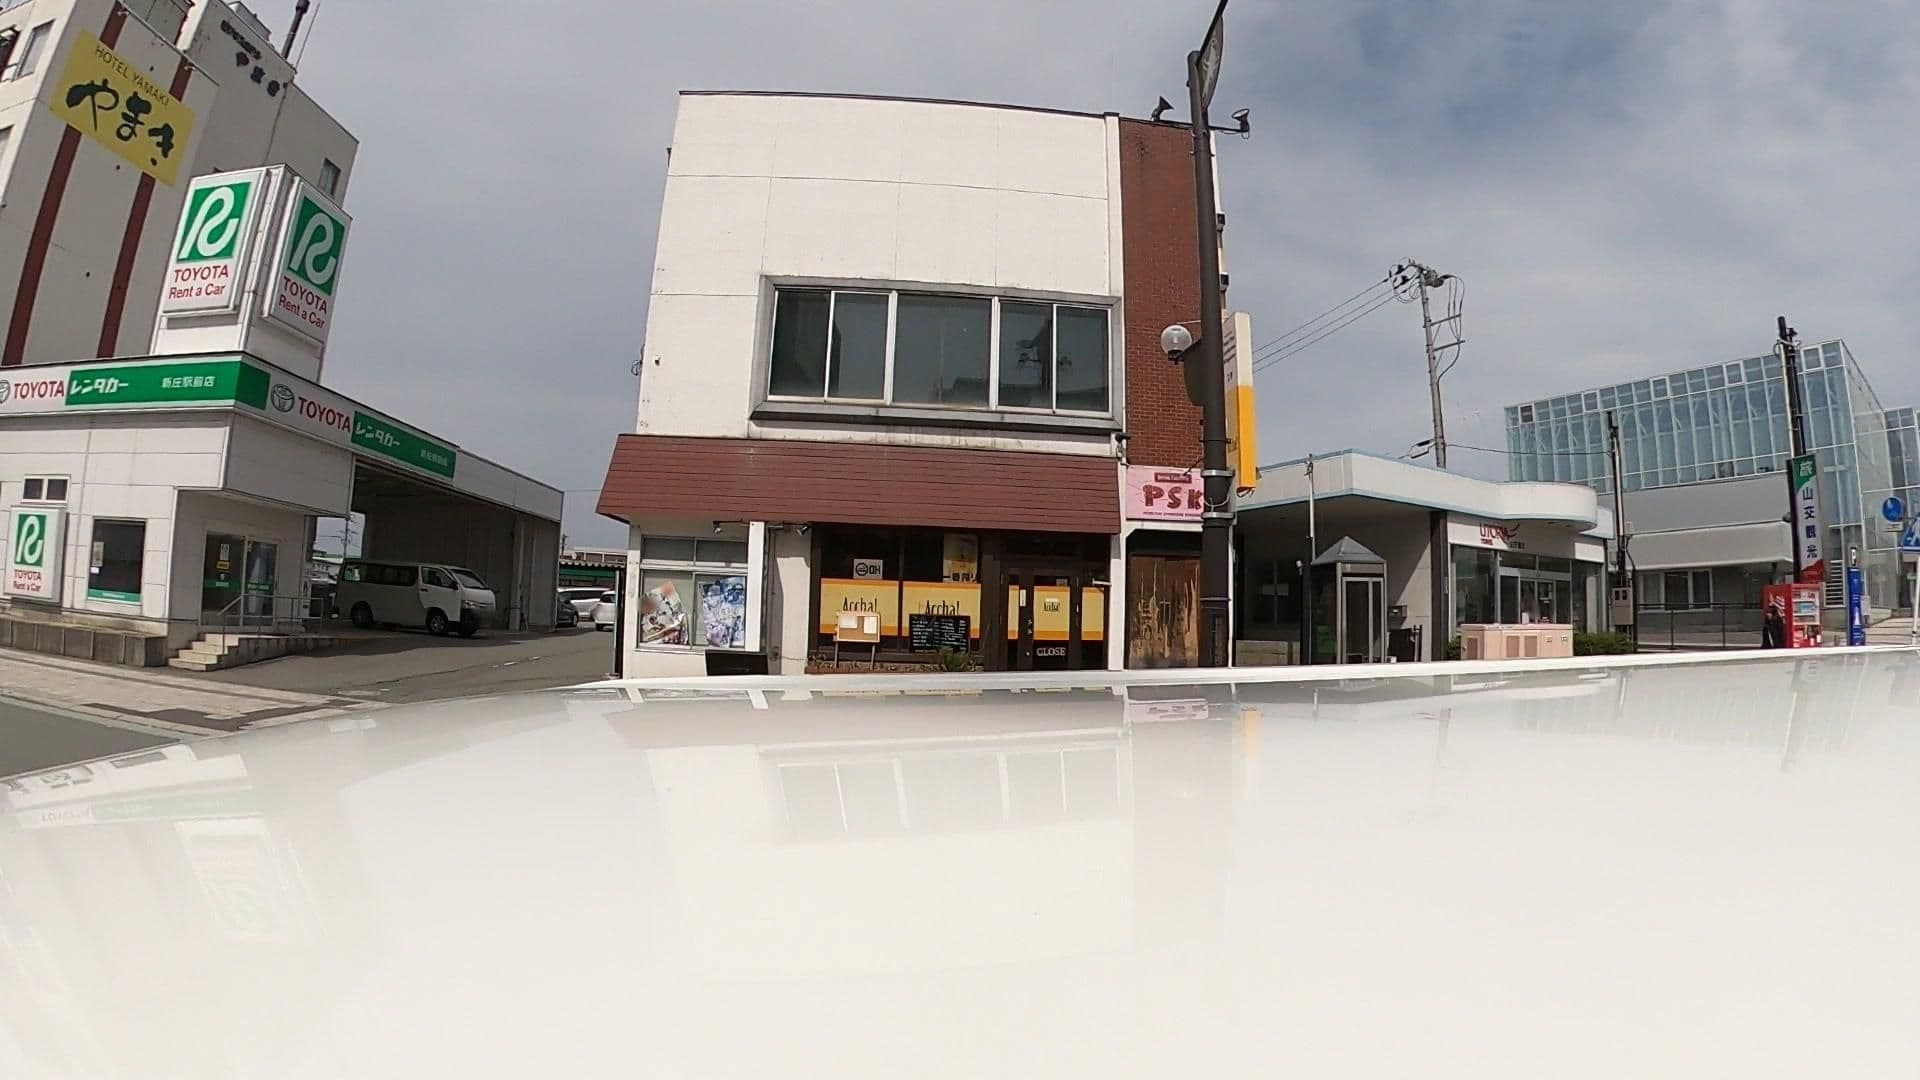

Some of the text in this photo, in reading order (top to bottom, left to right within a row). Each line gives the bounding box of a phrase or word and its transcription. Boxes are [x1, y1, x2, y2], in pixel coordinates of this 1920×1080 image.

[95, 45, 129, 79] HOTEL
[173, 264, 229, 283] TOYOTA
[168, 283, 226, 300] Rent a Car
[283, 276, 329, 315] TOYOTA
[278, 294, 301, 316] Rent
[308, 310, 326, 329] Car
[13, 380, 65, 400] TOYOTA
[69, 376, 129, 396] レンタカー
[298, 397, 352, 434] TOYOTA
[355, 421, 401, 448] レンタカー
[14, 569, 41, 580] TOYOTA
[1036, 647, 1067, 657] CLOSE
